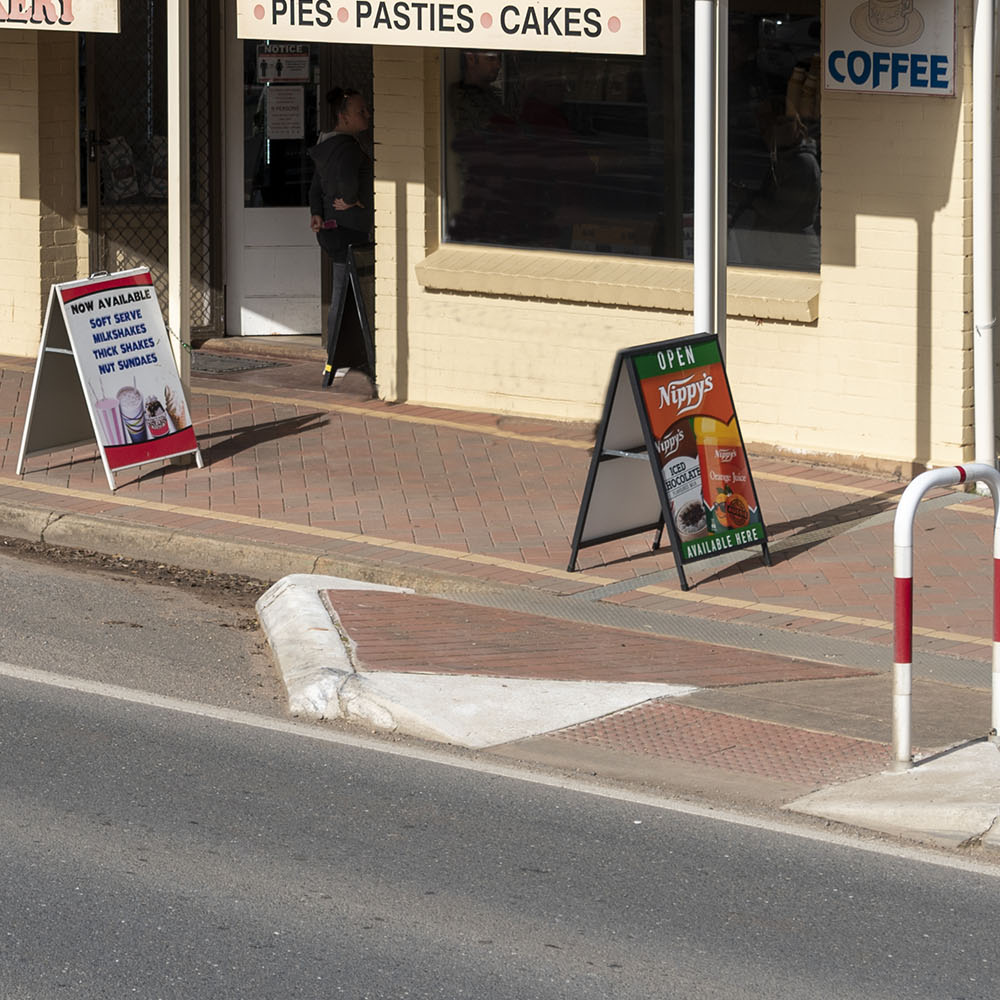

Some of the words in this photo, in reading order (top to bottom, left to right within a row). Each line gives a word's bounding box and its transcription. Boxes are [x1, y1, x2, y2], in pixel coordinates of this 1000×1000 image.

[355, 0, 475, 34] PASTIES
[500, 5, 602, 39] CAKES
[264, 45, 303, 53] NOTICE
[828, 50, 949, 90] COFFEE
[71, 300, 95, 315] NOW
[98, 289, 152, 310] AVAILABLE
[89, 316, 112, 329] SOFT
[115, 309, 143, 324] SERVE
[92, 324, 147, 344] MILKSHAKES
[93, 345, 119, 360] THICK
[120, 337, 155, 354] SHAKES
[657, 345, 696, 371] OPEN
[98, 362, 116, 375] NUT
[118, 353, 158, 371] SUNDAES
[658, 372, 713, 416] Nippy's
[669, 462, 686, 476] ICED
[710, 471, 732, 483] Orange
[733, 471, 747, 483] Juice
[686, 535, 733, 559] AVAILABLE
[735, 528, 758, 546] HERE
